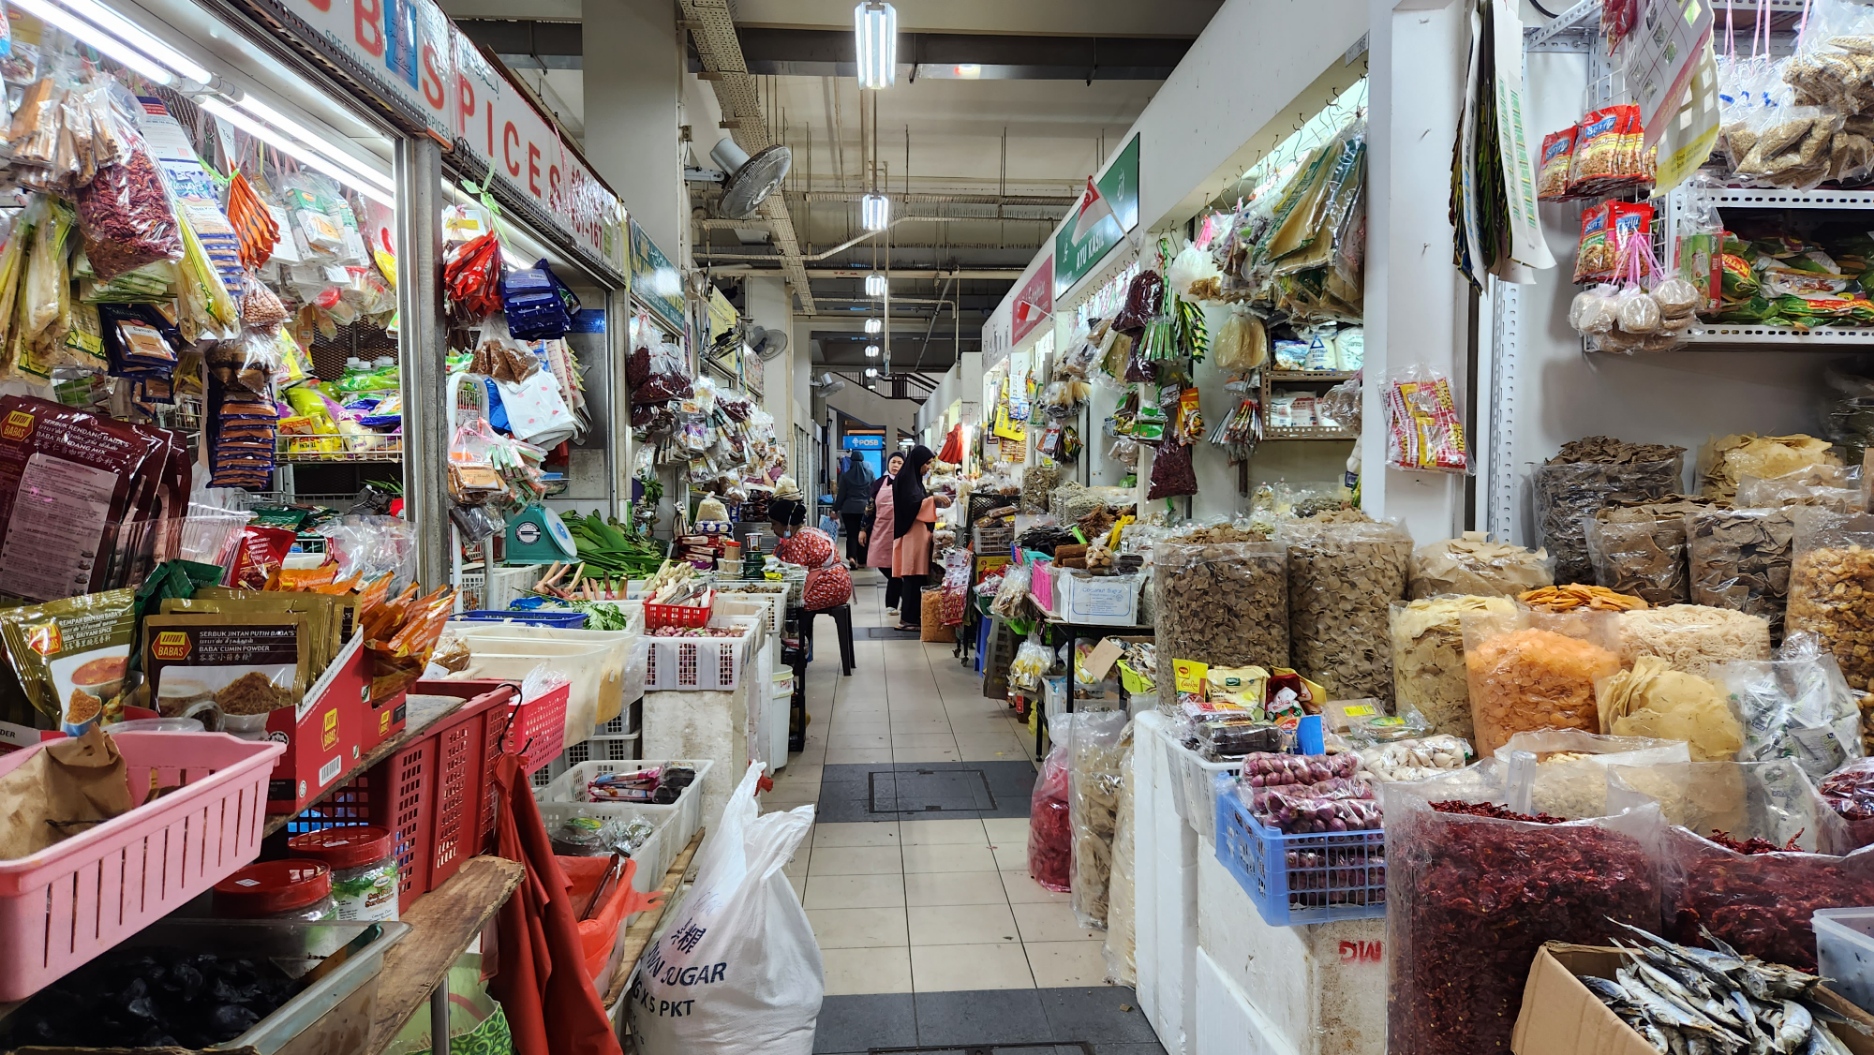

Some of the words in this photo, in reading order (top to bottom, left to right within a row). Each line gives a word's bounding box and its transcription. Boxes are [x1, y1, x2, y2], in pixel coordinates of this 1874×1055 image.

[421, 42, 563, 214] SPICES
[426, 112, 451, 140] SPICES
[3, 424, 26, 438] BABAS
[68, 422, 103, 440] RENDANG
[157, 646, 184, 657] BABAS
[660, 962, 727, 987] SUGAR
[659, 999, 696, 1018] PKT
